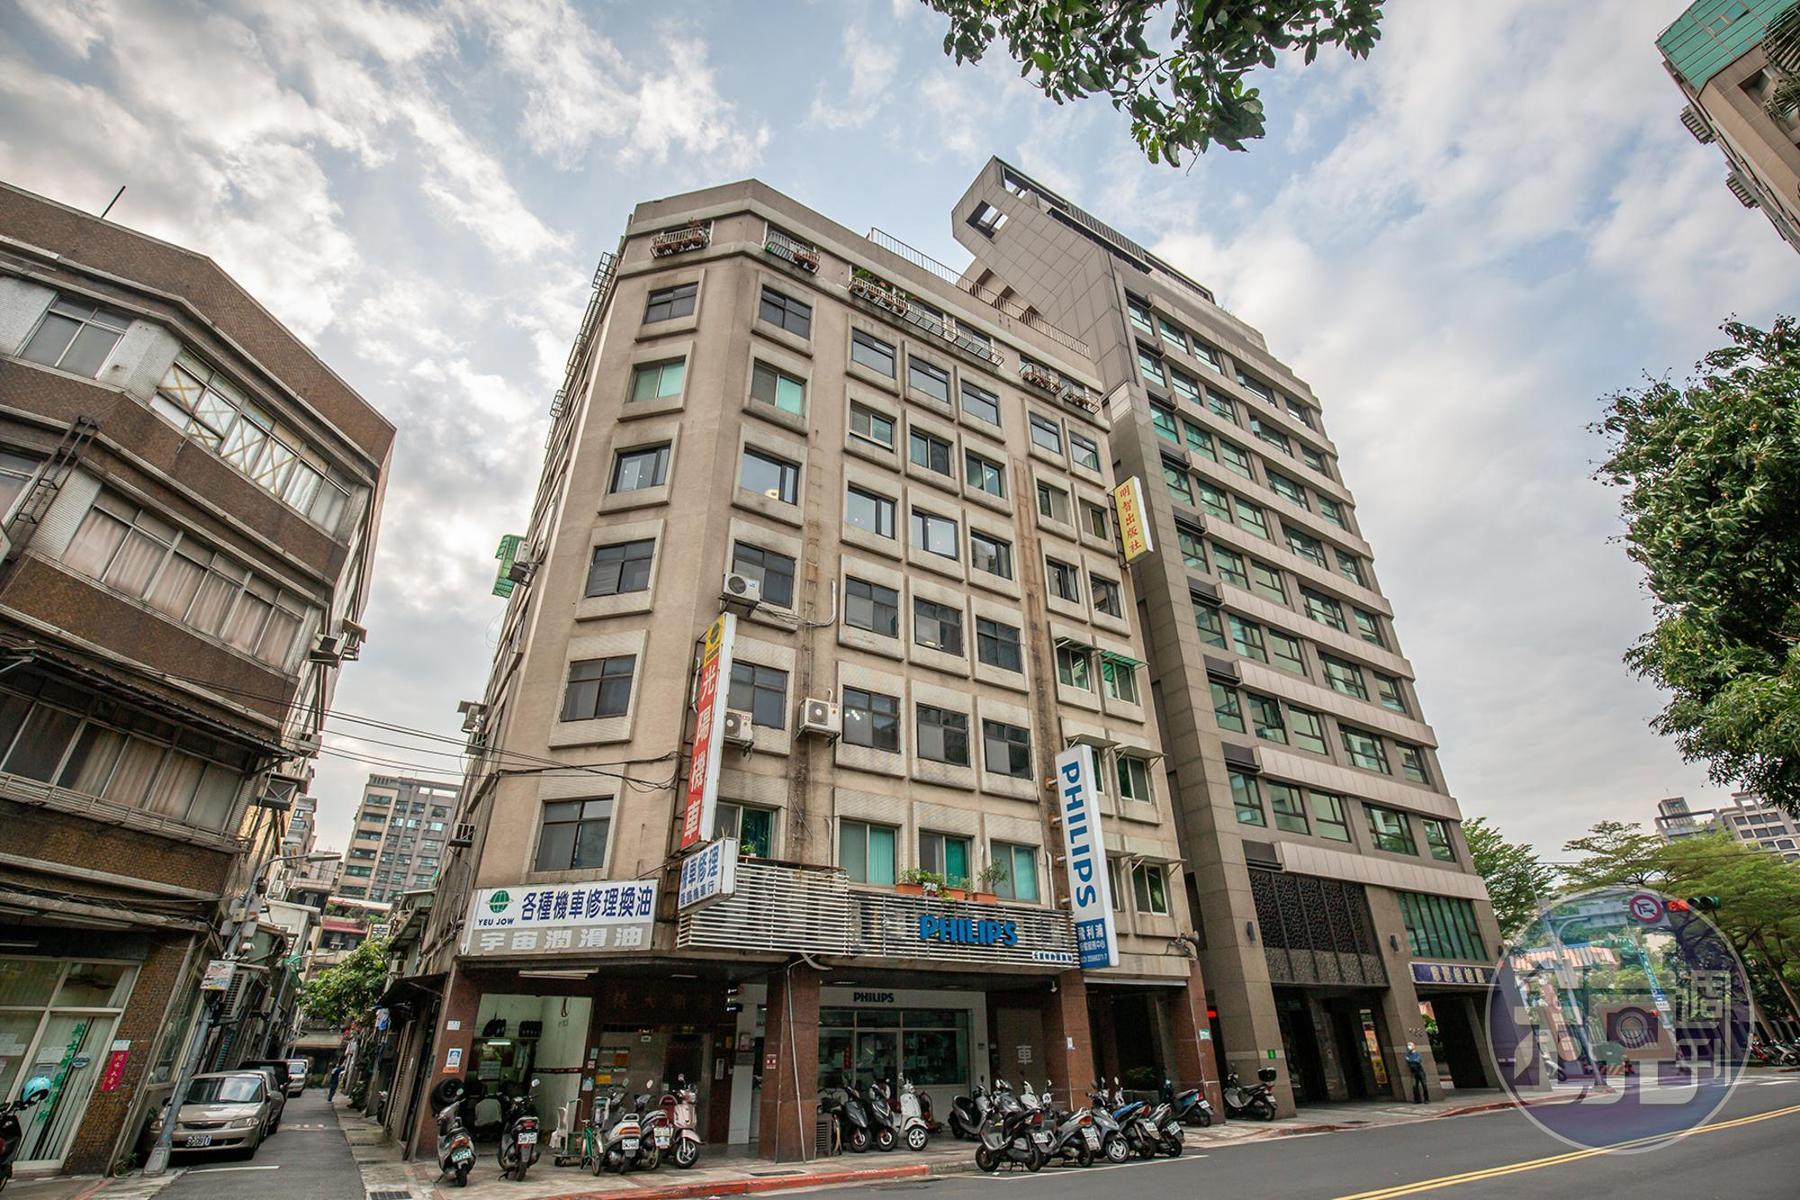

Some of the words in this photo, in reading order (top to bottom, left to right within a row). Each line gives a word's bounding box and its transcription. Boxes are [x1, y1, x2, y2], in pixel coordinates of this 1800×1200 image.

[684, 665, 717, 842] 光陽機車
[1061, 760, 1096, 908] PHILIPS
[521, 886, 652, 922] 各種機車修理換油
[478, 917, 494, 927] YEU
[496, 917, 514, 926] JOW
[919, 914, 1018, 947] PHILIPS
[479, 926, 643, 952] 宇宙潤滑油
[853, 991, 895, 1004] PHILIPS
